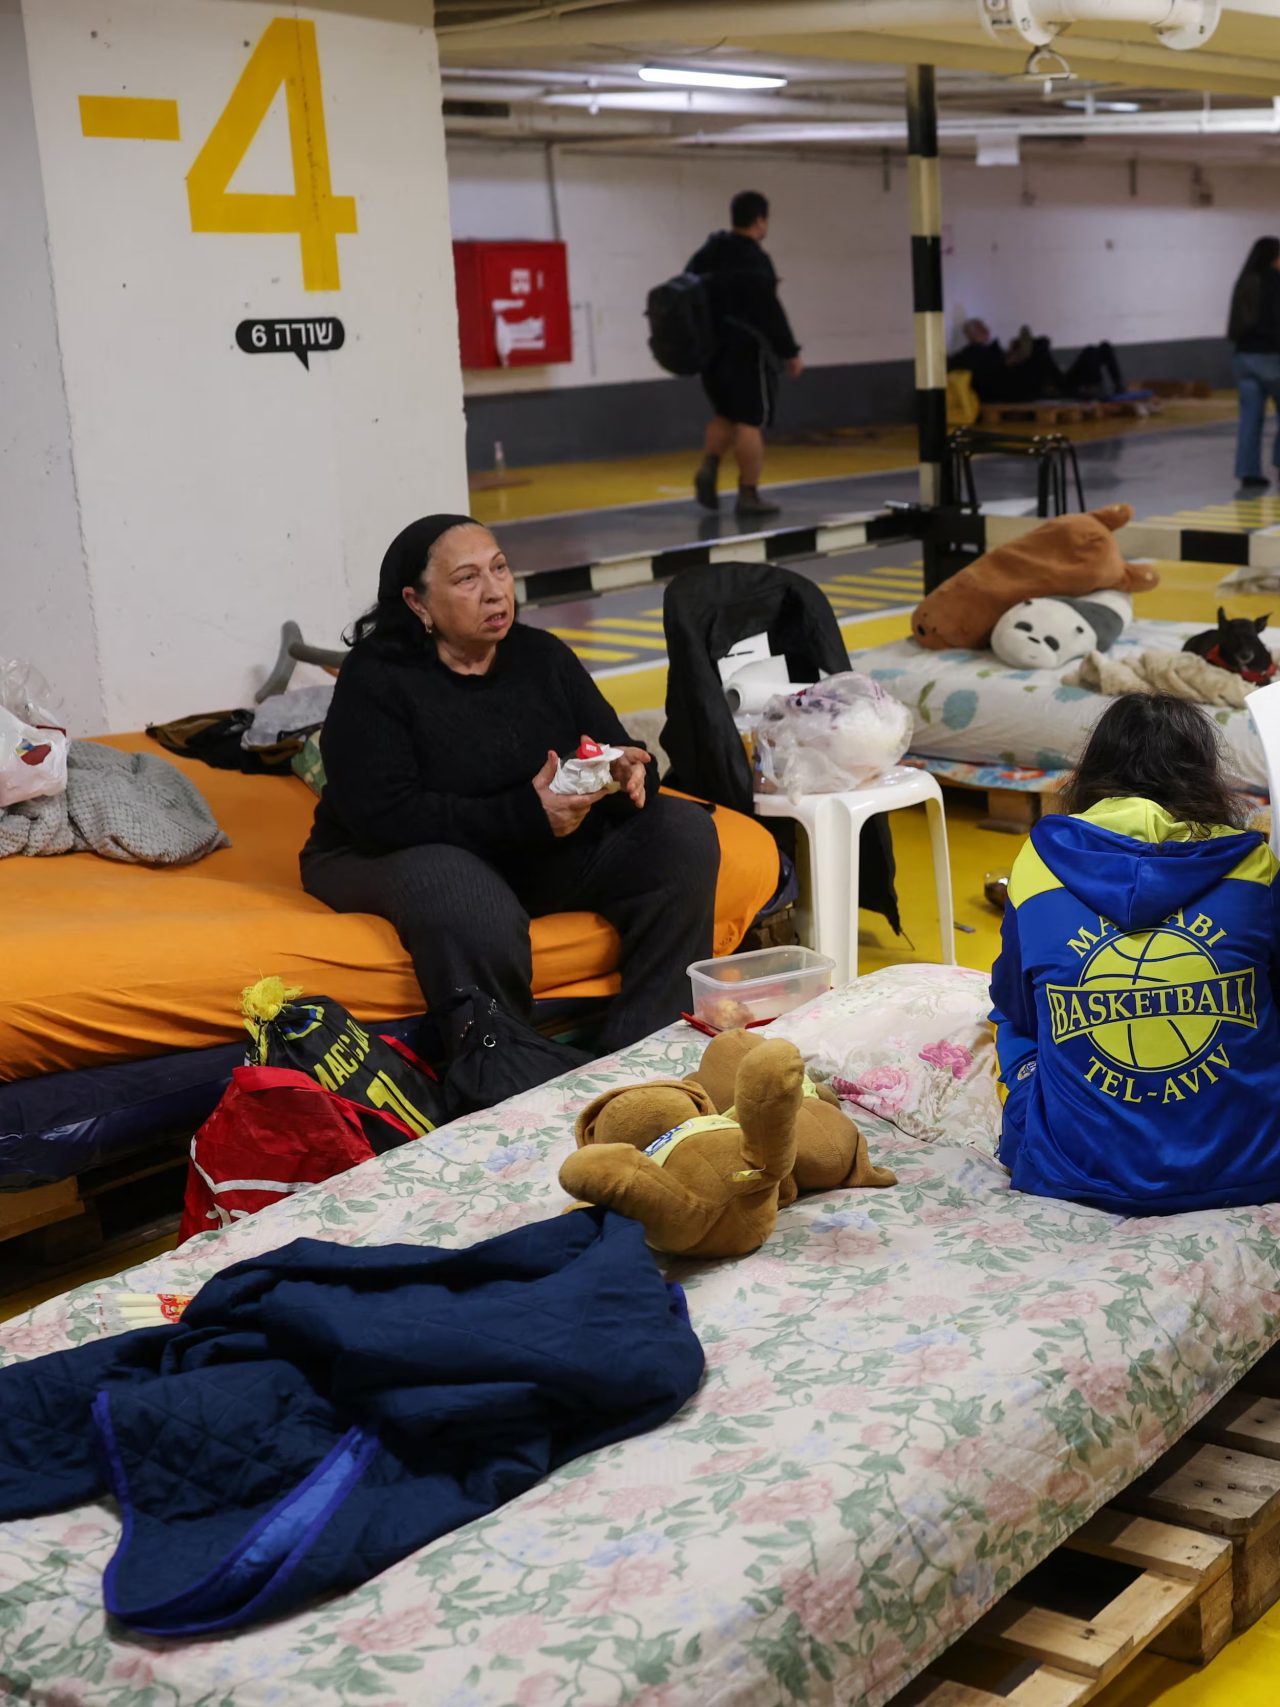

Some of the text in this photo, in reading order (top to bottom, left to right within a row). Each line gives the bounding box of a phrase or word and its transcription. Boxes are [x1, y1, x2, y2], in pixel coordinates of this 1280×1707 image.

[78, 17, 358, 291] -4
[251, 322, 333, 348] שורה 6
[1067, 907, 1228, 958] MAABI
[1050, 977, 1252, 1036] BASKETBALL
[1084, 1043, 1230, 1104] TEL-AVIV
